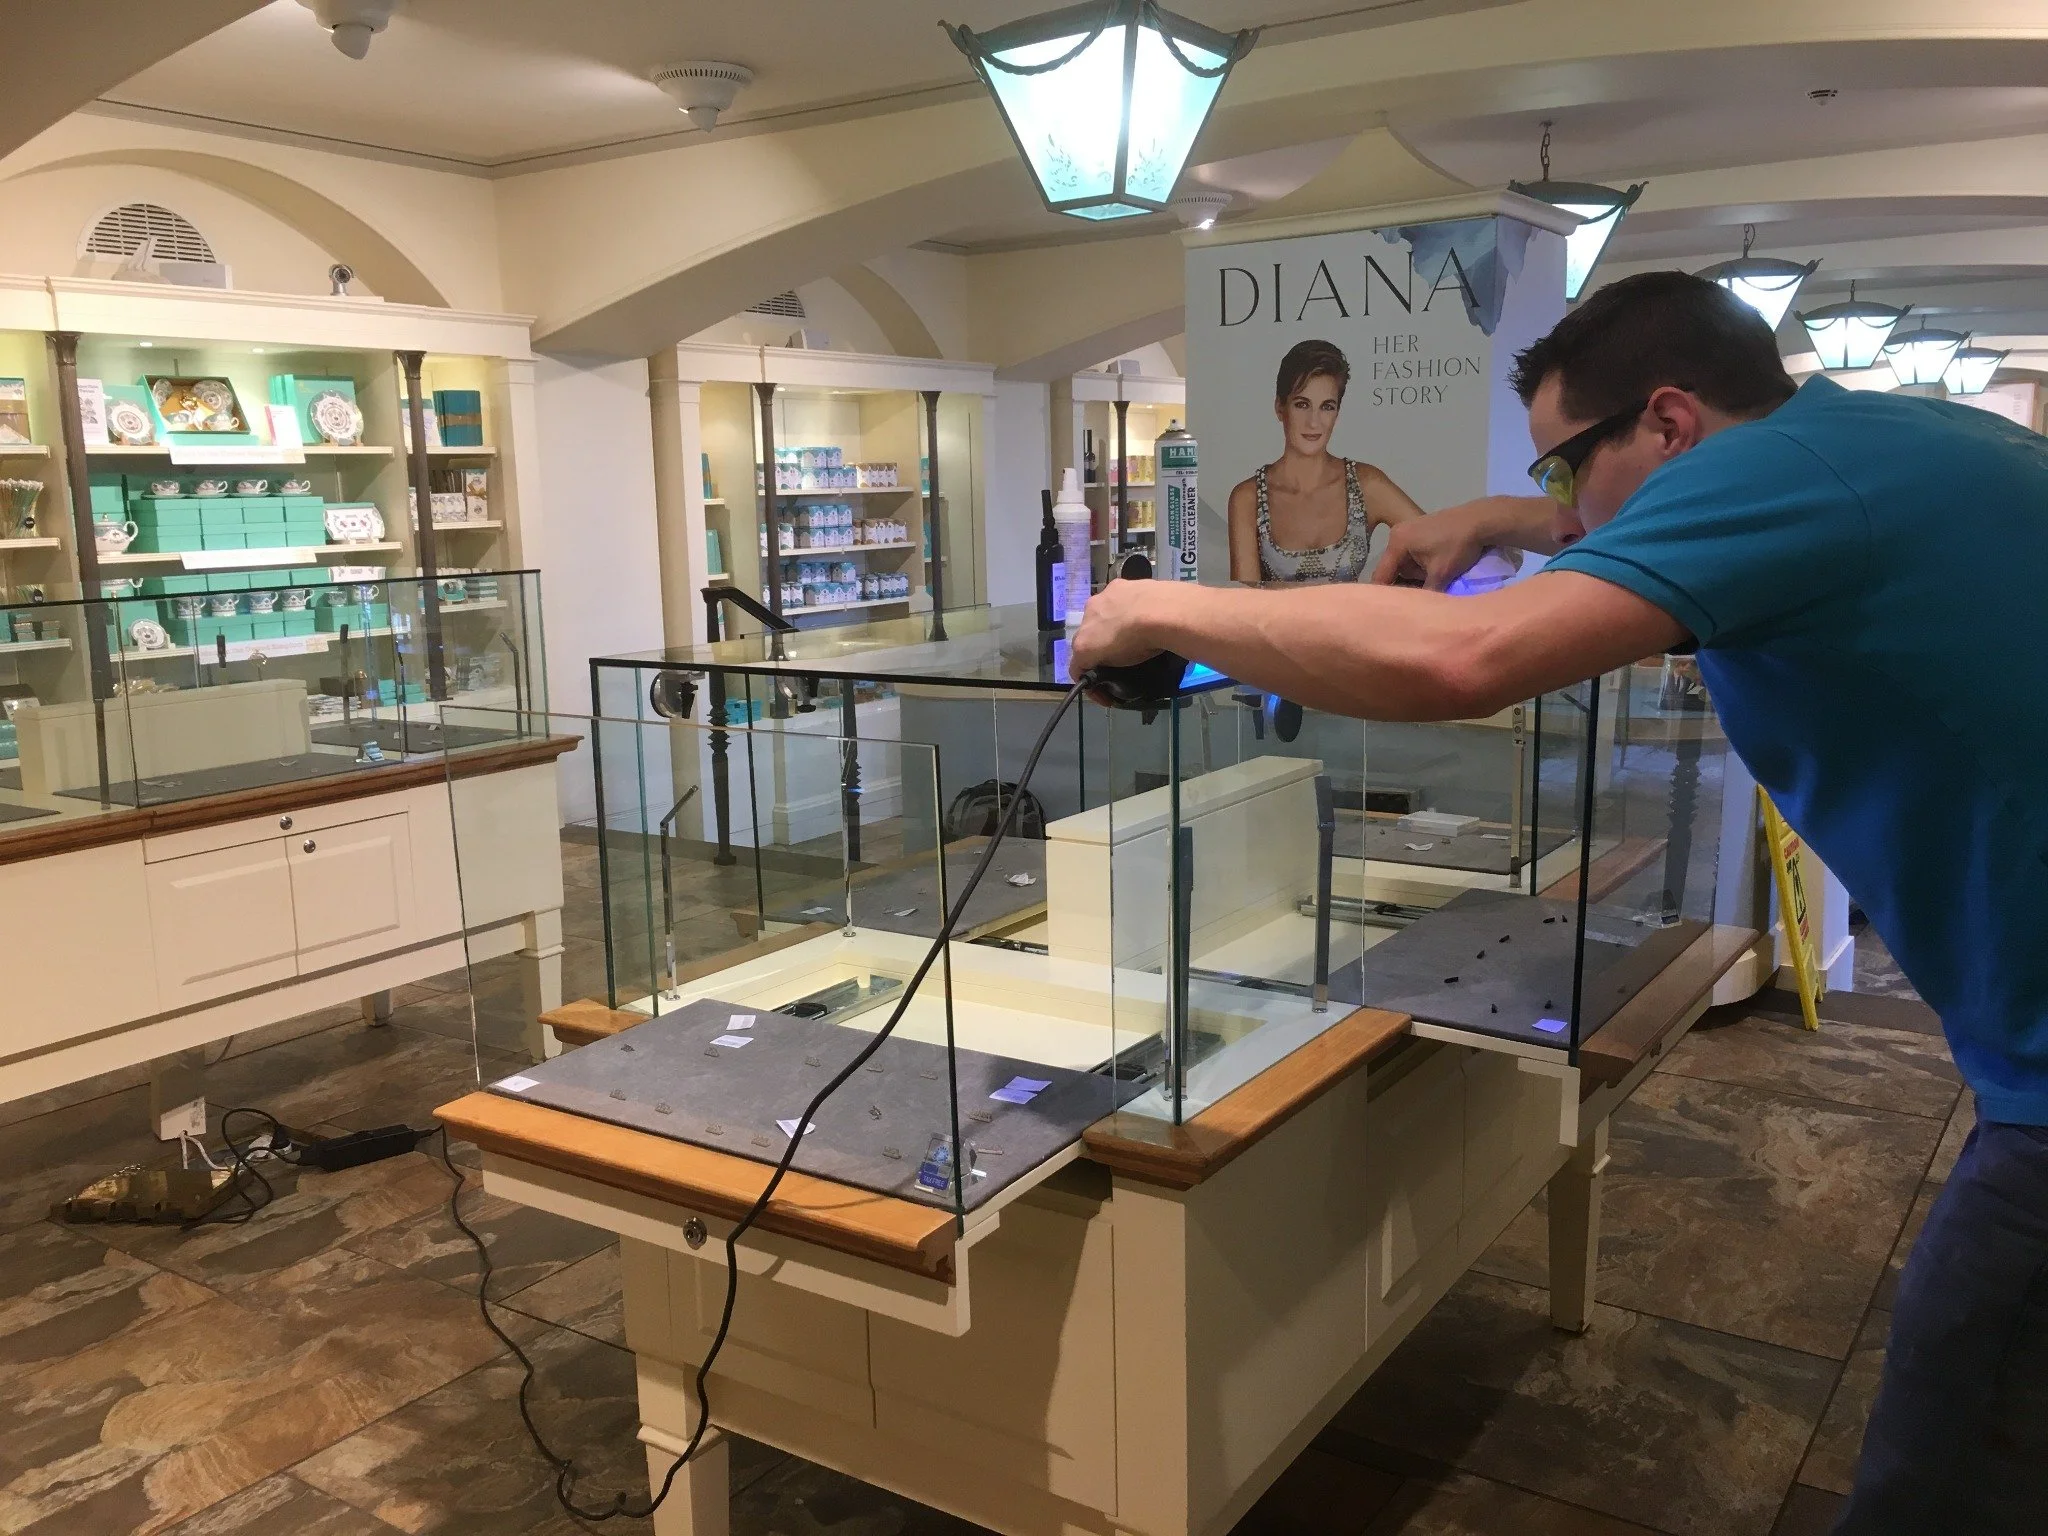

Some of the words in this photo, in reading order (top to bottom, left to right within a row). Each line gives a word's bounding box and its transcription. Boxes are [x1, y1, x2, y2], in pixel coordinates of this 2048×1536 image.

[1219, 246, 1481, 327] DIANA
[1373, 334, 1419, 354] HER
[1373, 356, 1481, 380] FASHION
[1372, 384, 1448, 407] STORY
[1187, 486, 1196, 527] CLEANER
[1181, 529, 1197, 565] GLASS
[923, 1175, 933, 1184] TAX
[932, 1178, 945, 1188] FREE
